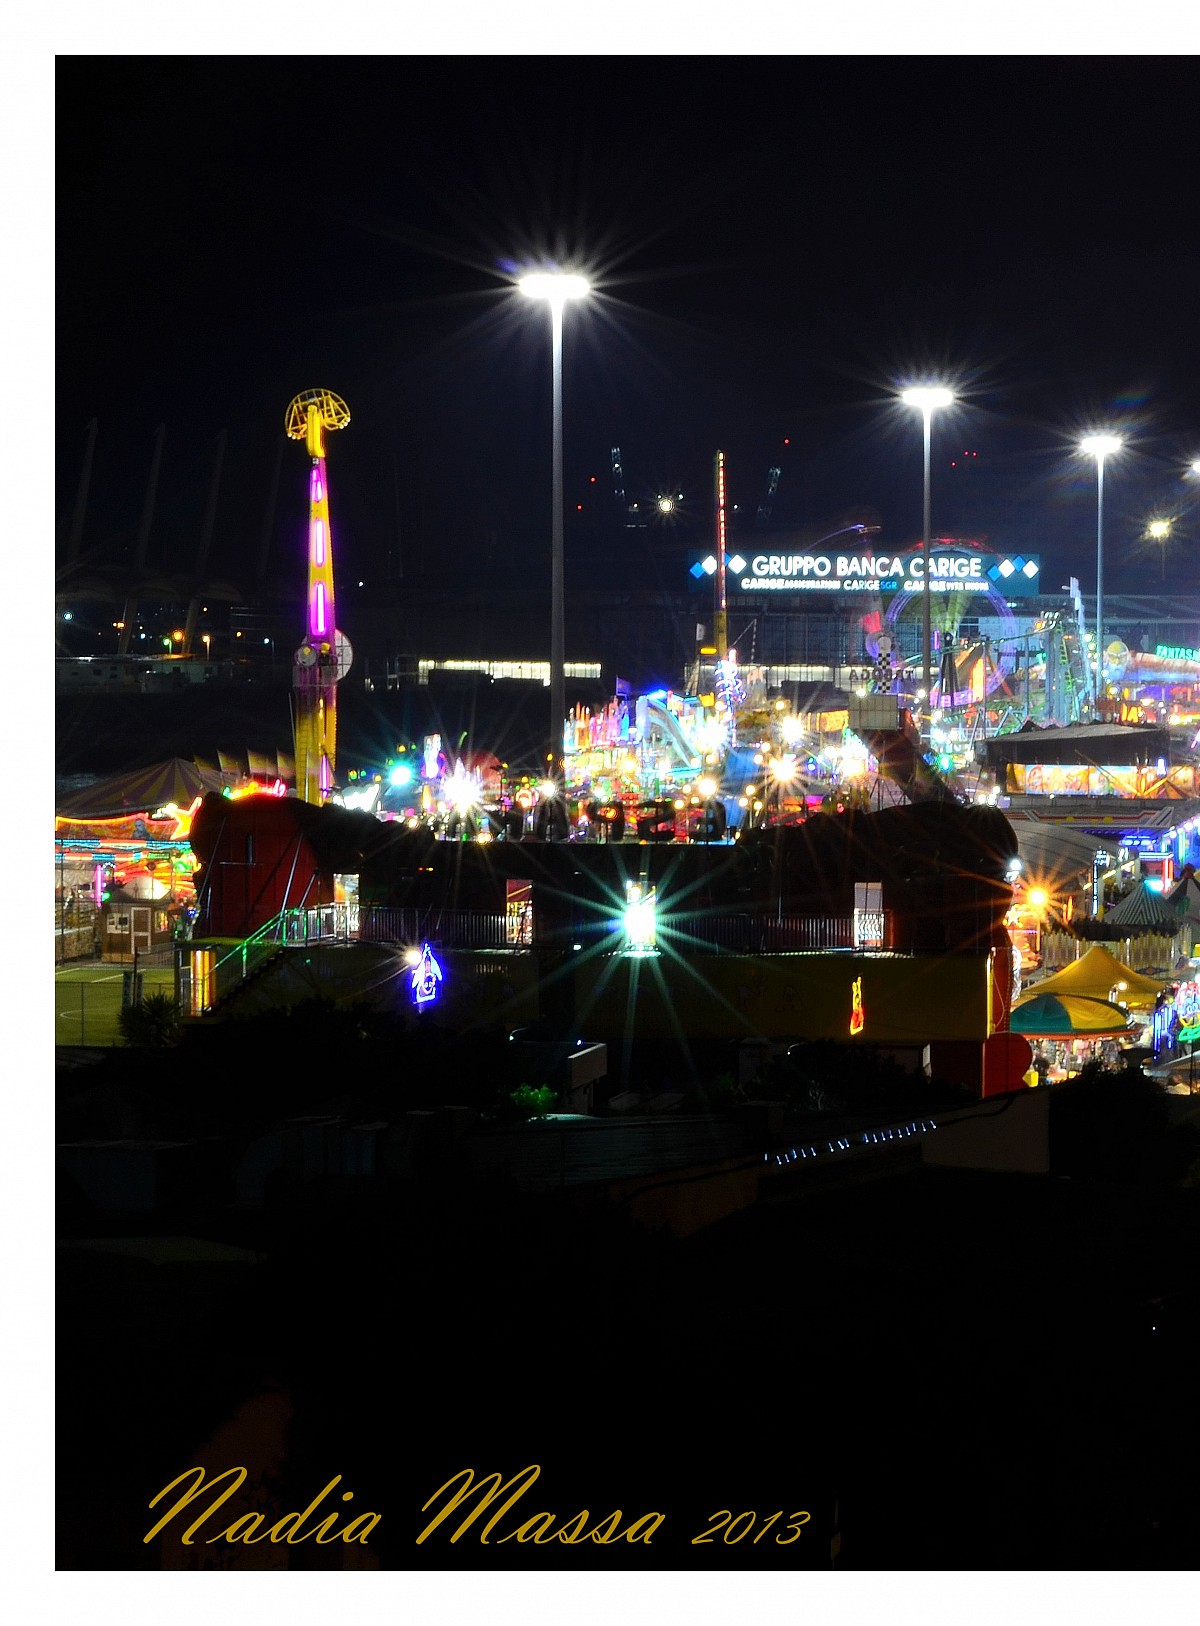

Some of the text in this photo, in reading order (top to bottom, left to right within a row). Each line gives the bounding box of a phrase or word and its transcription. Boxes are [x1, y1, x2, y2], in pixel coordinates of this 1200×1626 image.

[752, 555, 982, 578] GRUPPO BANCA CARIGE
